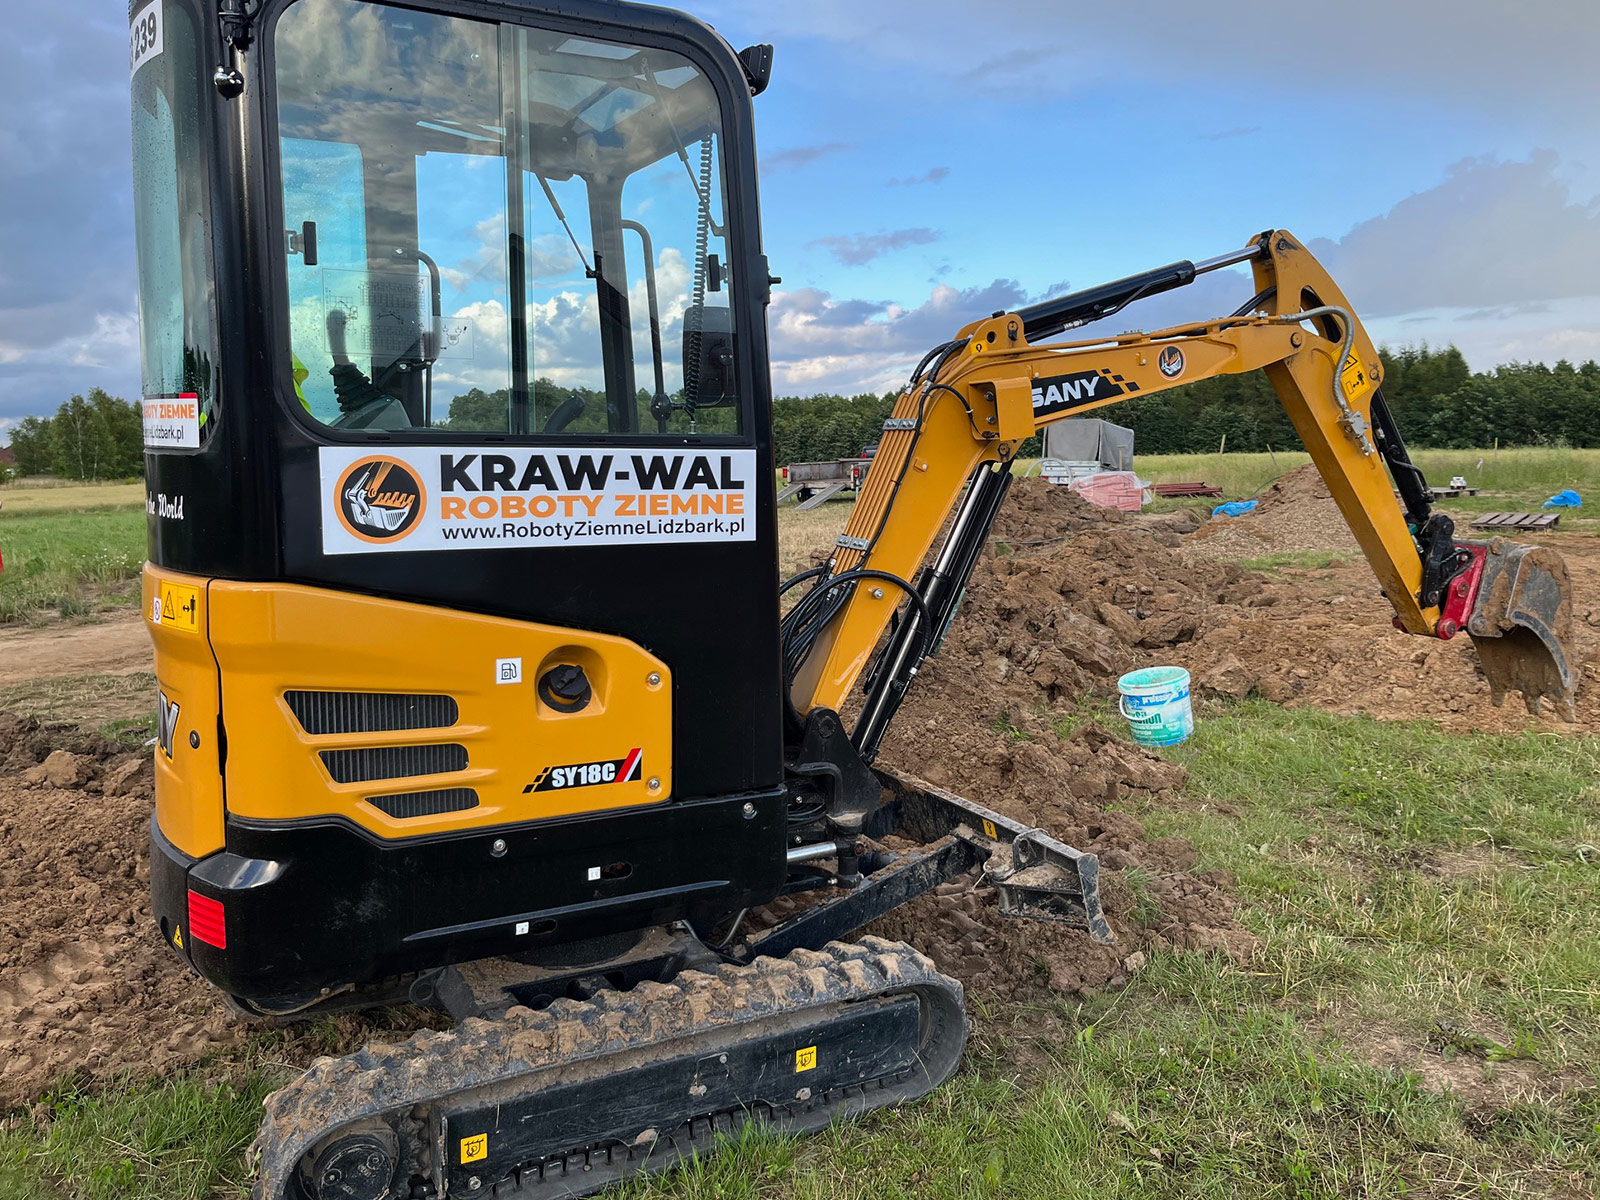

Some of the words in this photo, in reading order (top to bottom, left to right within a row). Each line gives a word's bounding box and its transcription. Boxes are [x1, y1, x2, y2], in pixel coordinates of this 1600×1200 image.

[1032, 375, 1100, 409] SANY
[159, 403, 196, 419] ZIEMNE
[440, 454, 745, 492] KRAW-WAL
[157, 493, 185, 520] World
[440, 495, 605, 520] ROBOTY
[614, 494, 745, 517] ZIEMNE
[442, 518, 745, 541] www.RobotyZiemneLidzbark.pl
[551, 763, 616, 788] SY18C
